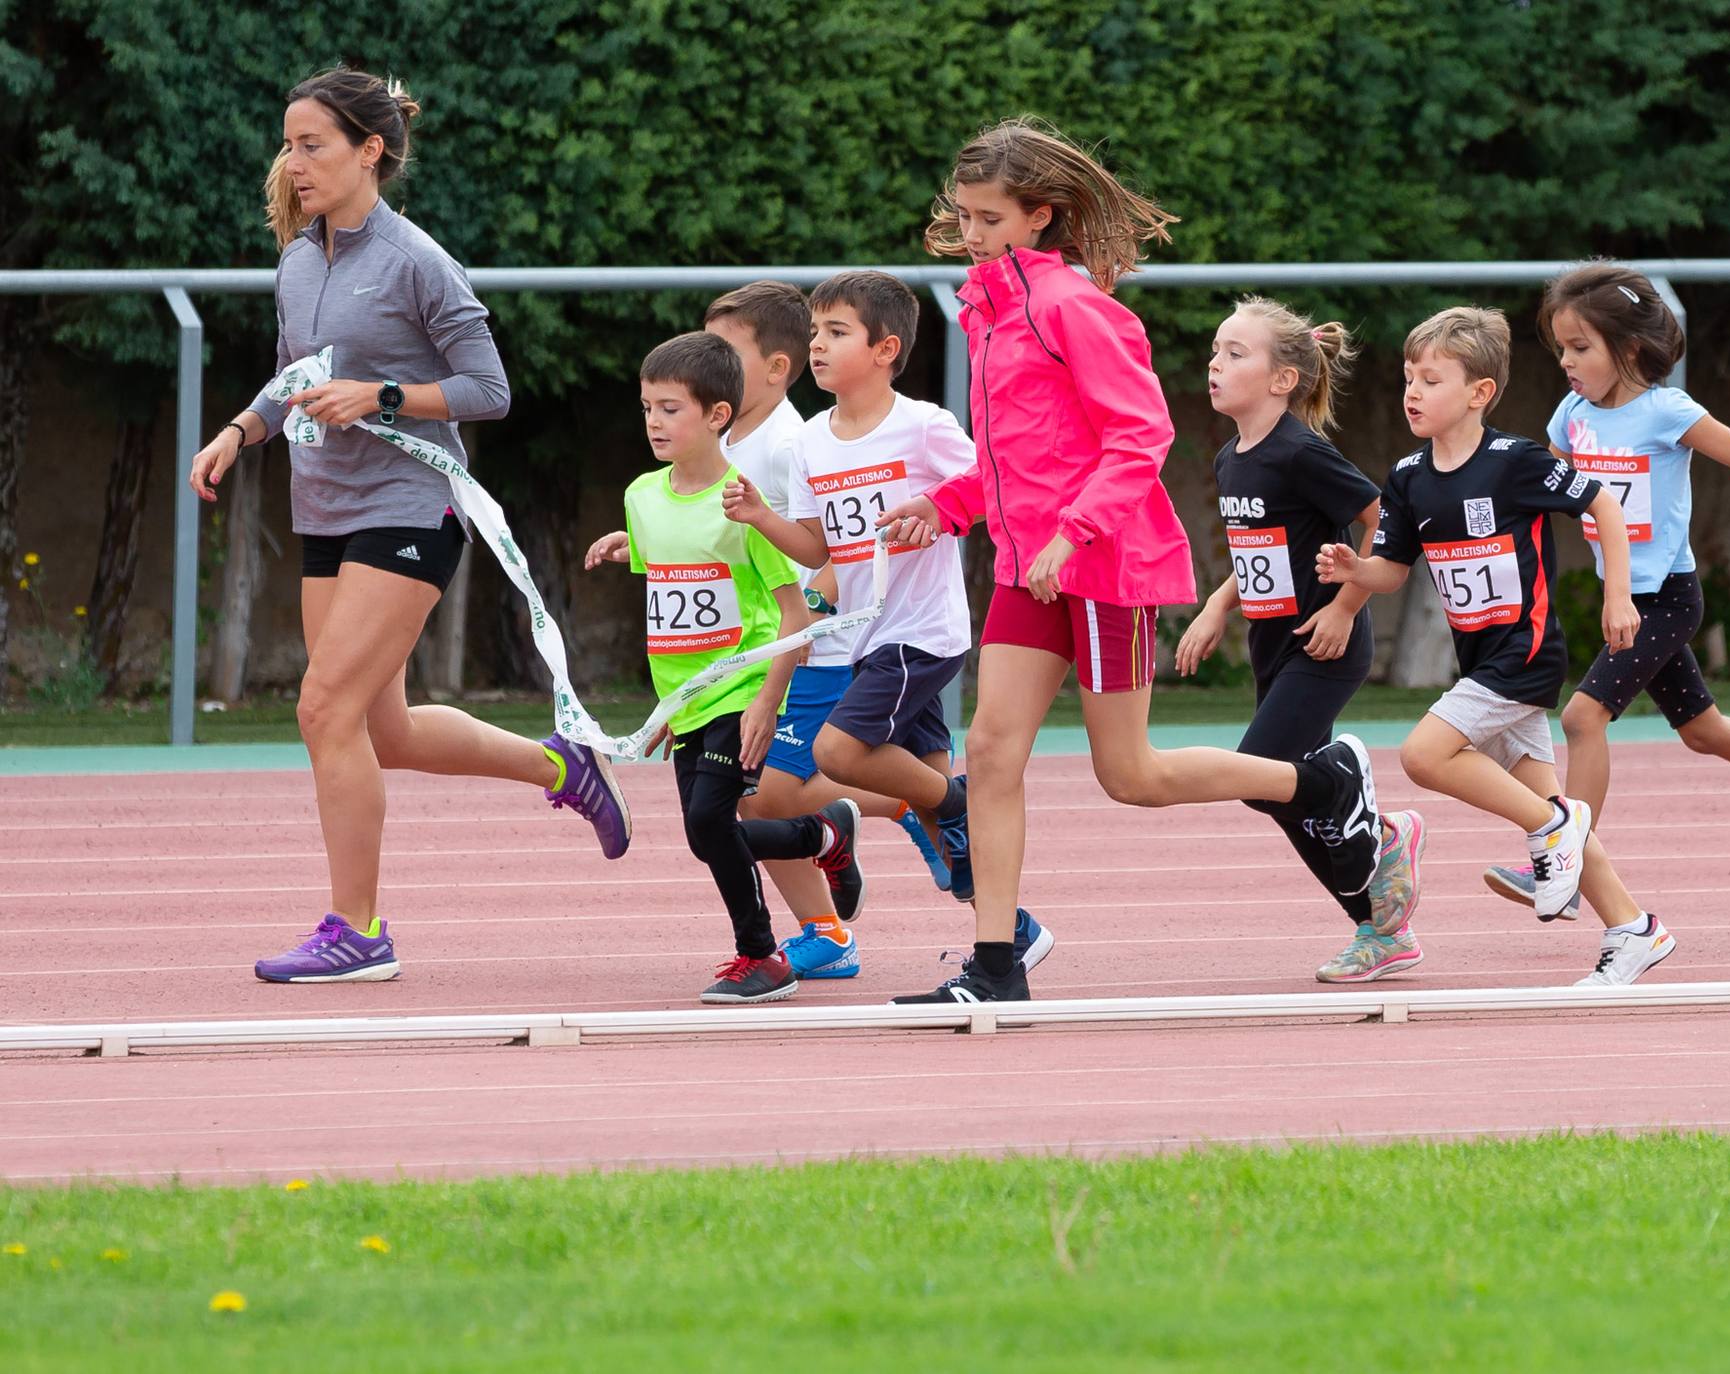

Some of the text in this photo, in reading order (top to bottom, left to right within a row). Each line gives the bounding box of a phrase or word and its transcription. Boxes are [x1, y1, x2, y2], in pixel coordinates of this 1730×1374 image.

[1488, 438, 1517, 451] NIKE
[410, 448, 428, 461] de
[430, 455, 448, 470] La
[1395, 452, 1424, 472] NIKE
[1590, 460, 1638, 472] ATLETISMO
[813, 468, 894, 493] RIOJA ATLETISMO
[825, 491, 887, 540] 431
[1233, 534, 1274, 546] ATLETISMO
[1450, 543, 1501, 558] ATLETISMO
[668, 568, 719, 580] ATLETISMO
[1235, 555, 1275, 595] 98
[1438, 564, 1503, 608] 451
[648, 588, 721, 630] 428
[773, 732, 805, 747] RCURY
[704, 751, 733, 765] KIPSTA
